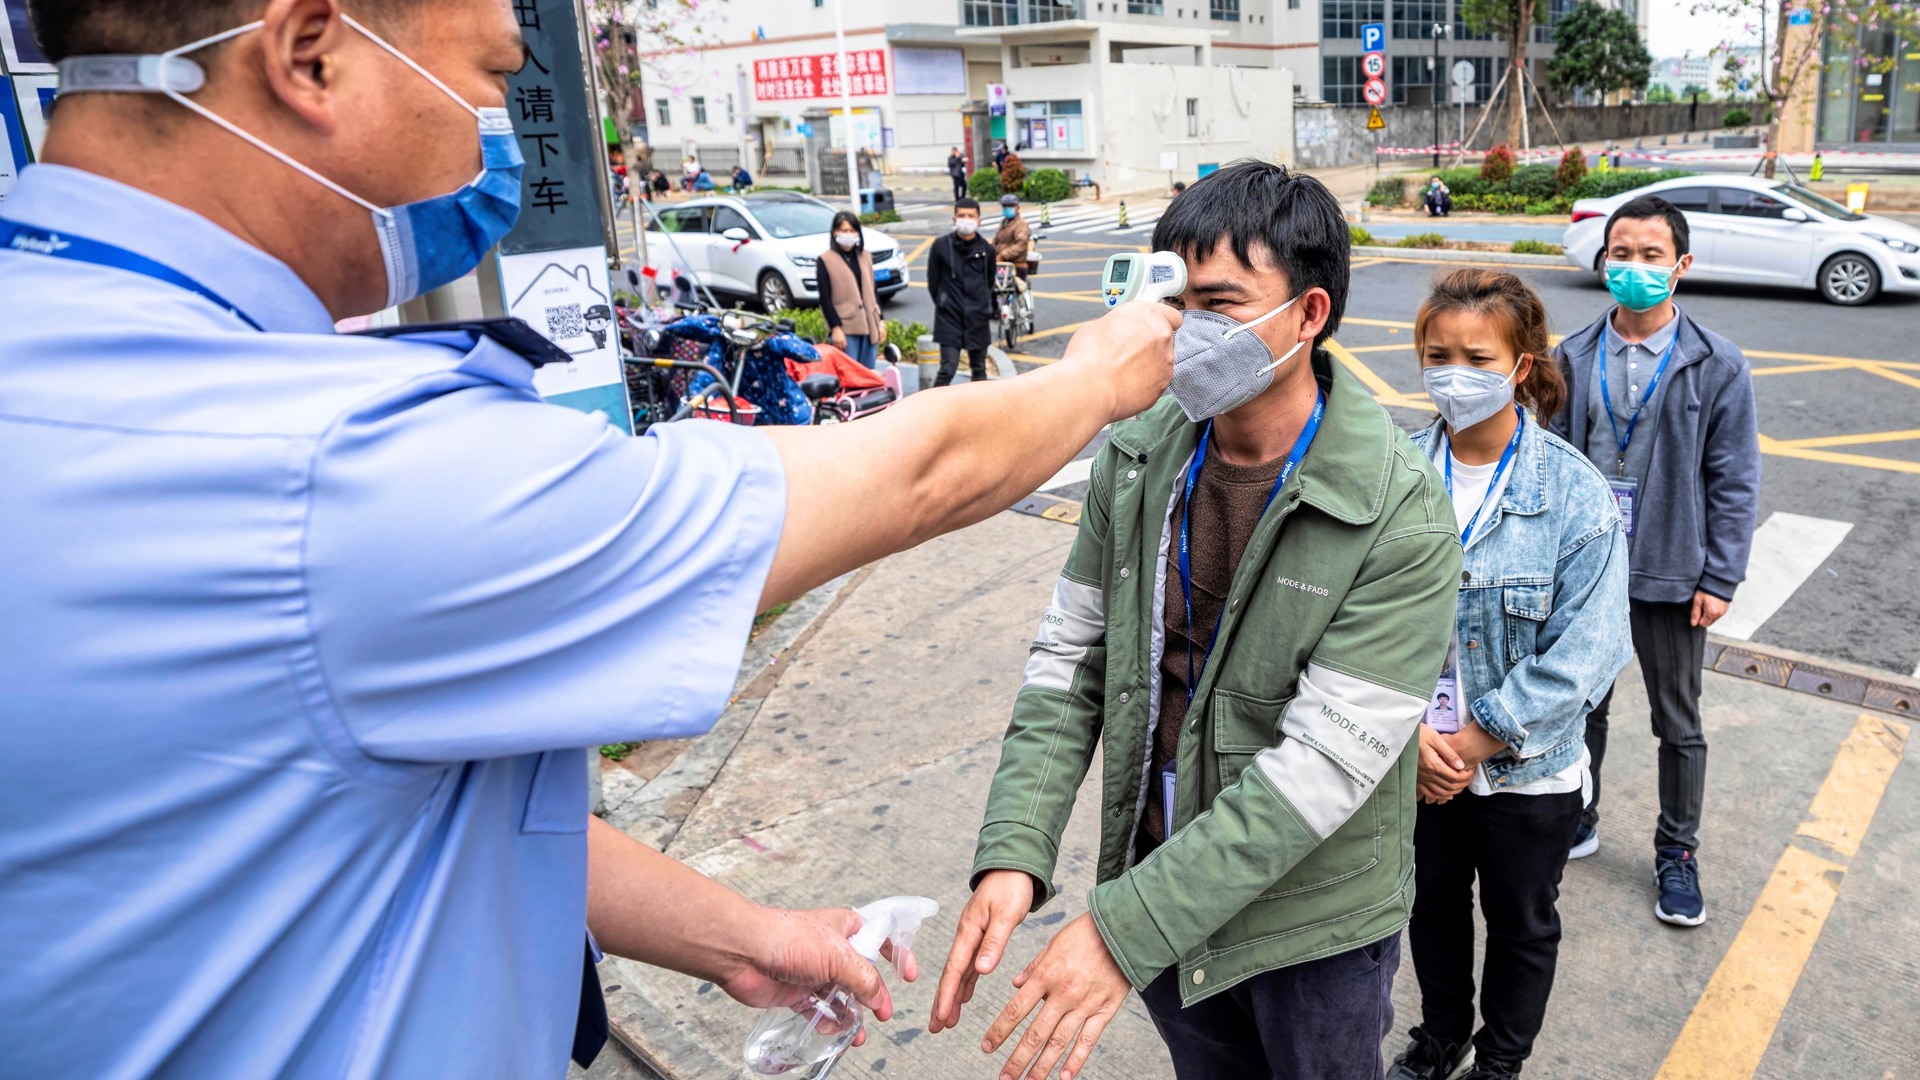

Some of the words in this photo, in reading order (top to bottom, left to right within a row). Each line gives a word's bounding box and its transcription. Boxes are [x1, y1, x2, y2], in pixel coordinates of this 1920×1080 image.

[1366, 28, 1380, 49] P
[1367, 58, 1380, 73] 15
[1281, 461, 1294, 479] Hytera
[1277, 576, 1299, 589] MODE
[1307, 584, 1329, 597] FADS
[1320, 704, 1359, 736] MODE
[1358, 731, 1367, 743] &
[1367, 736, 1390, 758] FADS
